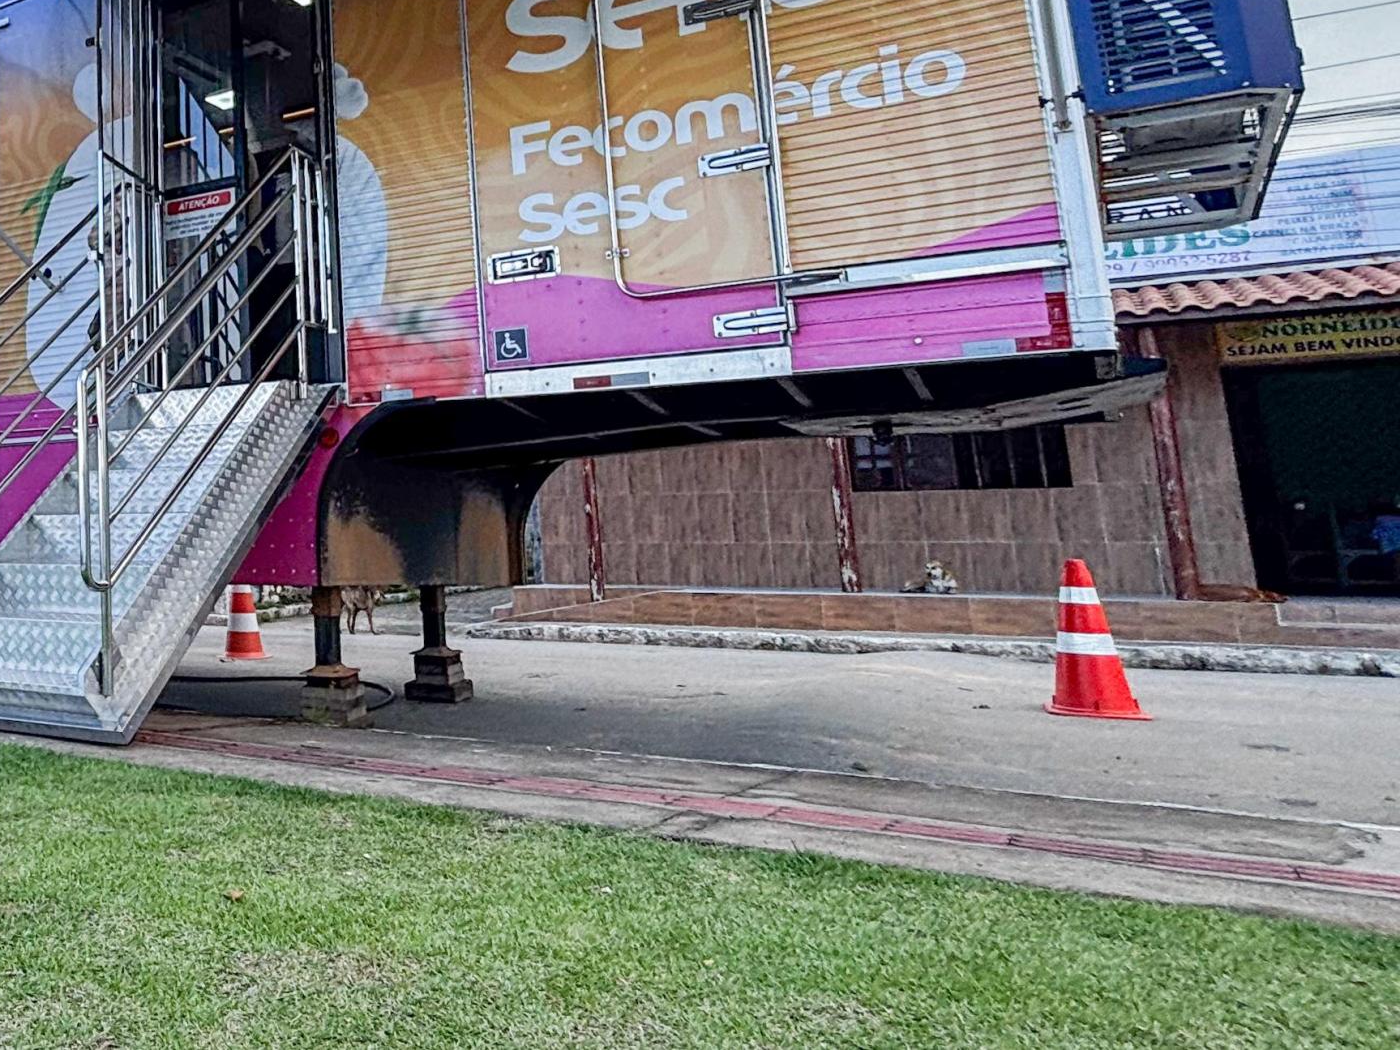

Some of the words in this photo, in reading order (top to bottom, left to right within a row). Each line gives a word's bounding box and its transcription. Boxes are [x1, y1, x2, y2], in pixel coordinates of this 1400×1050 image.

[510, 44, 967, 175] Fecomércio
[178, 194, 220, 211] ATENÇÃO
[1227, 343, 1288, 357] SEJAM
[1294, 339, 1336, 353] BEM
